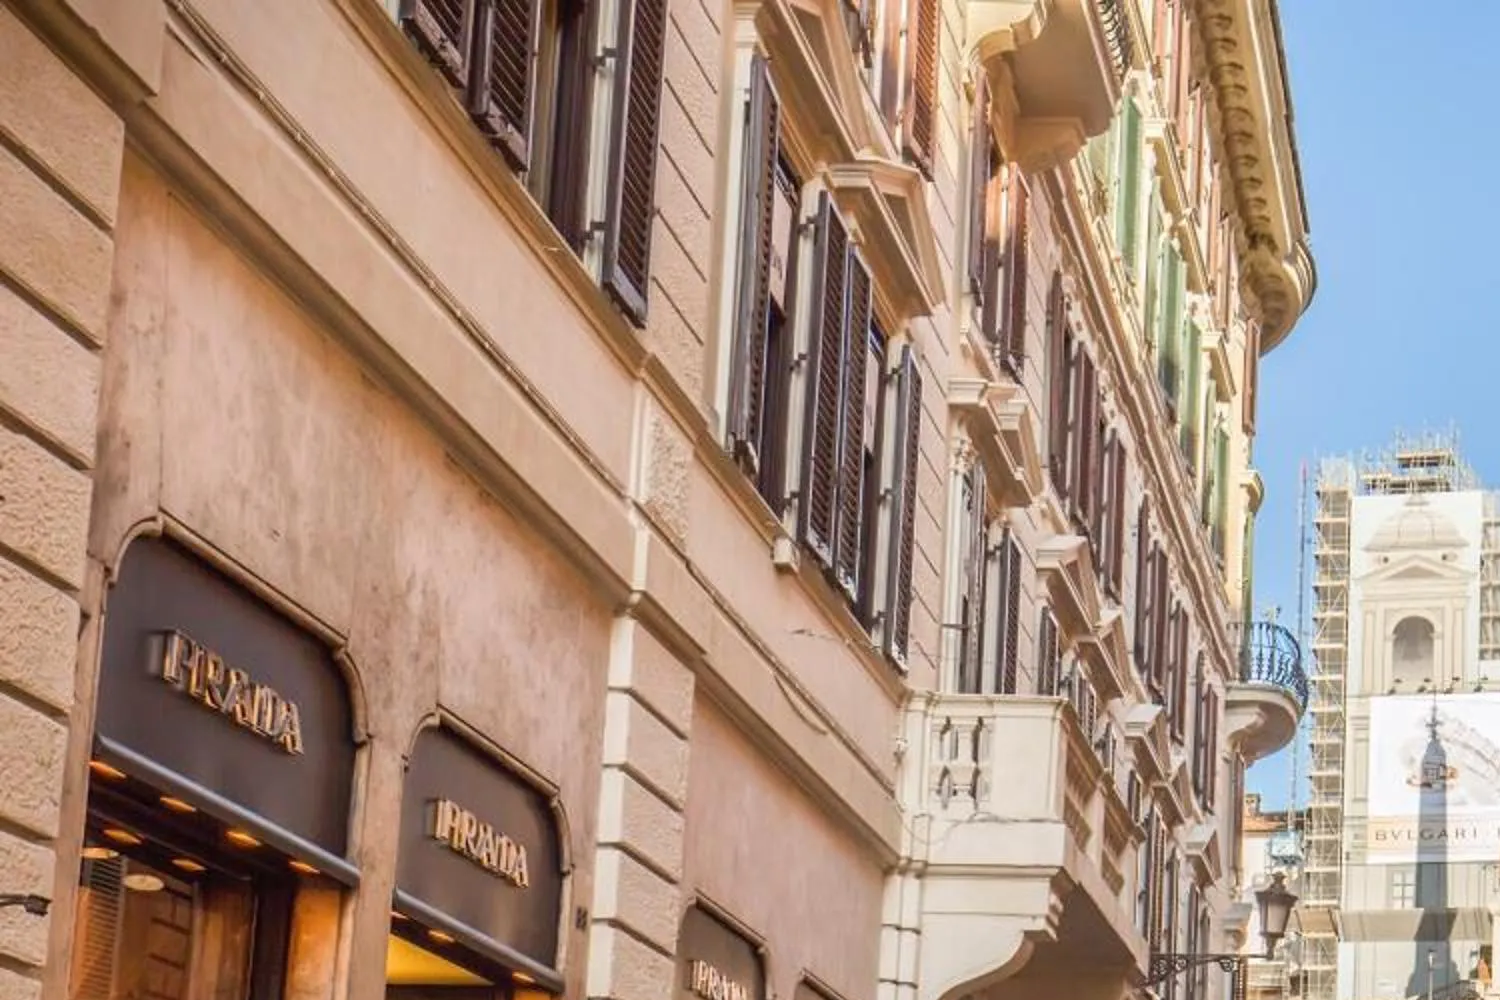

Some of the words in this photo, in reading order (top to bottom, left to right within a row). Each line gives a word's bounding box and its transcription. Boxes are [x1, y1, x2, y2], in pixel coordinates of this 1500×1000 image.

[162, 629, 304, 755] PRADA
[434, 797, 530, 888] PRADA
[1375, 827, 1478, 841] BVLGARI
